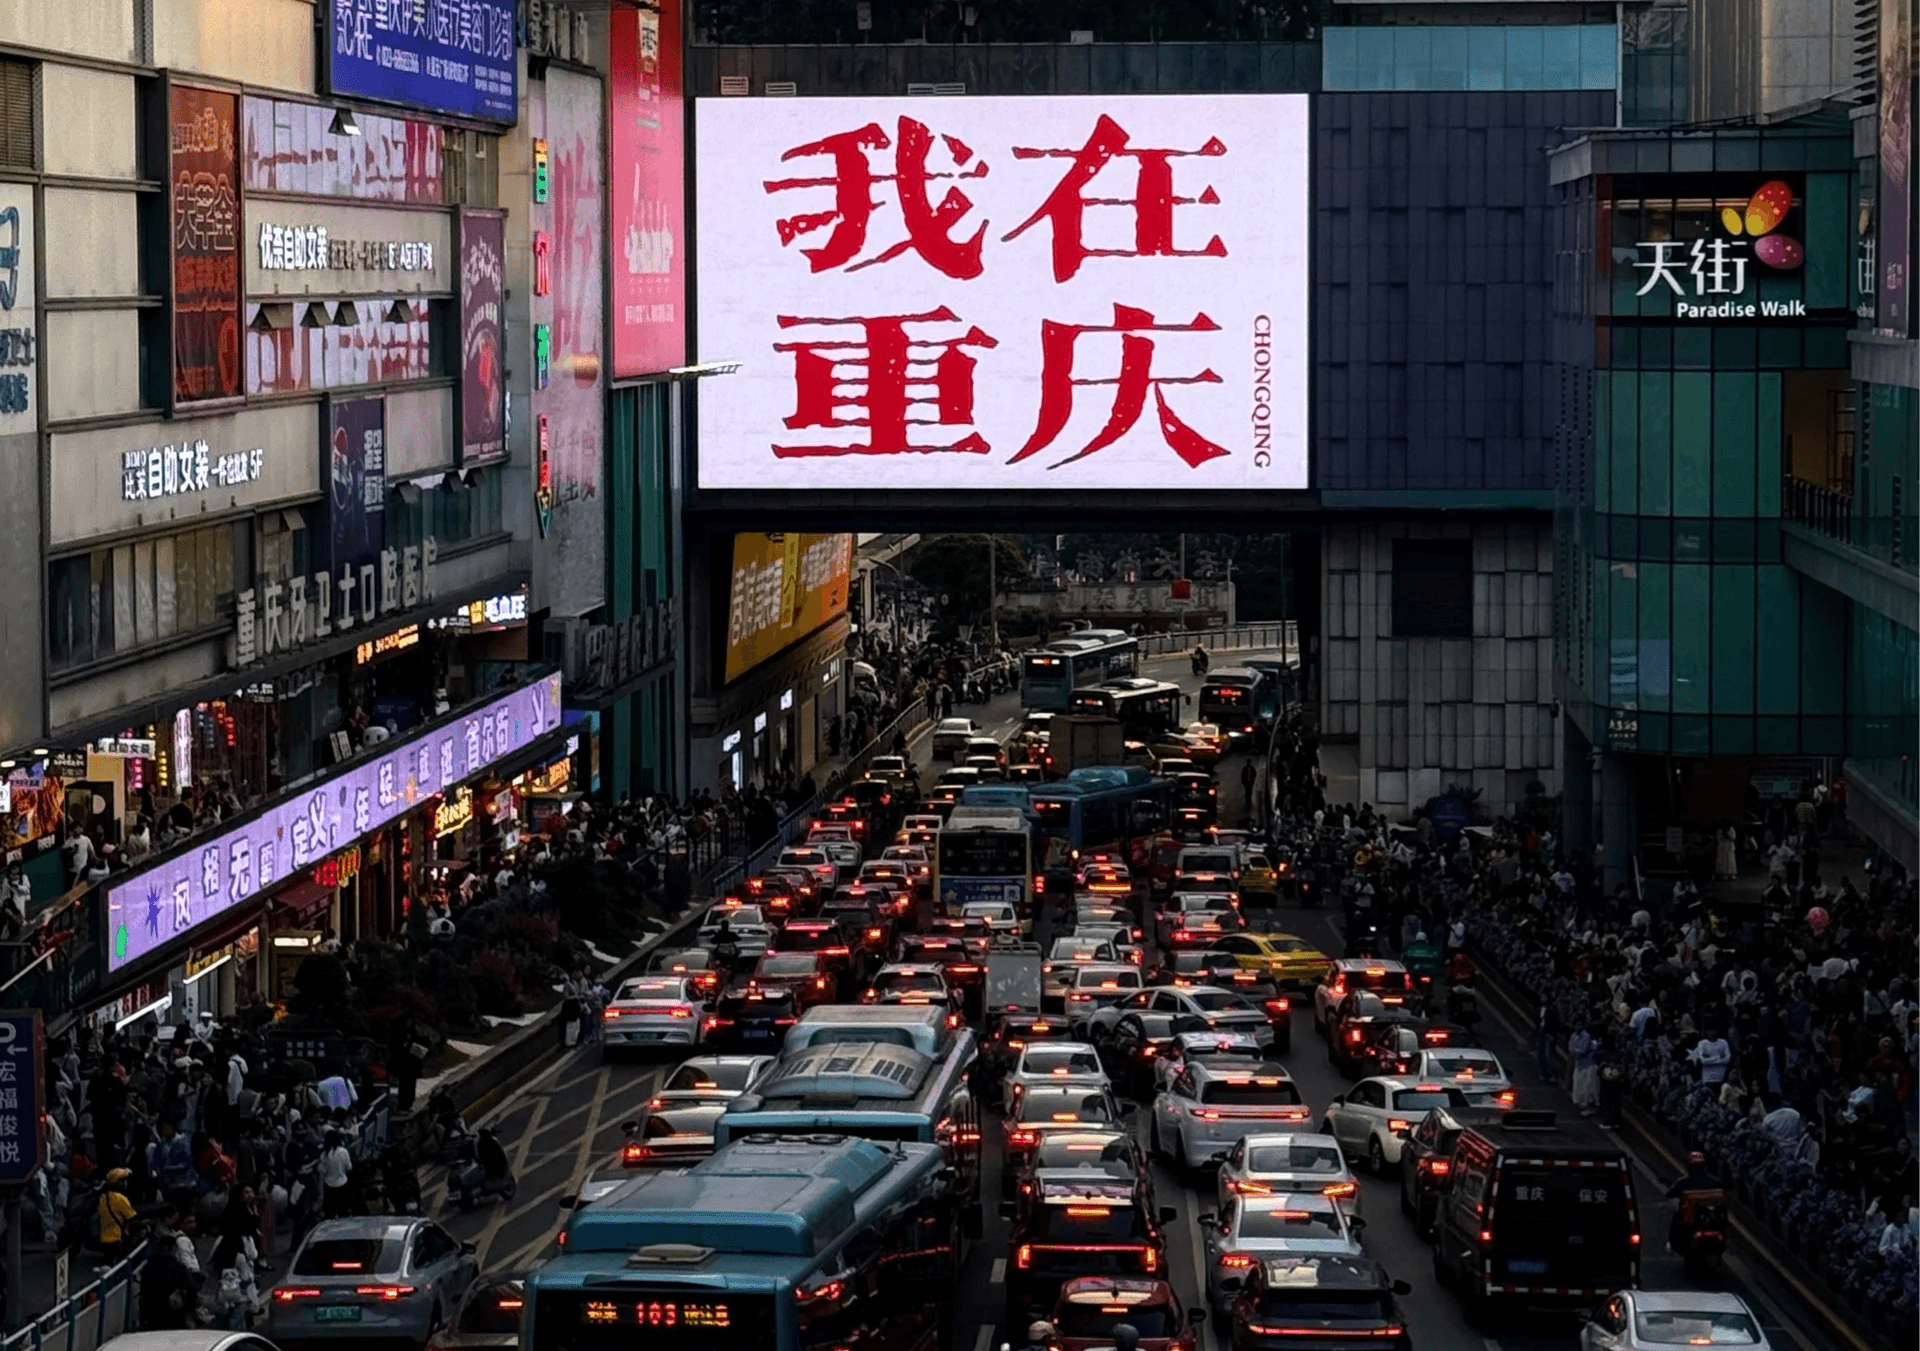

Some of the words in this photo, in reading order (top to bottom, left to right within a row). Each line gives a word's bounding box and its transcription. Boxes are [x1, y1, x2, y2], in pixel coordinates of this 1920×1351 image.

[763, 113, 1227, 283] 我在
[1632, 238, 1749, 296] 天街
[1677, 301, 1756, 318] Paradise
[1760, 300, 1806, 317] Walk
[770, 302, 1232, 469] 重庆
[1252, 314, 1272, 468] CHONGQING
[148, 439, 210, 498] 自助女装
[1514, 1185, 1545, 1202] 重庆
[1578, 1188, 1609, 1204] 保安
